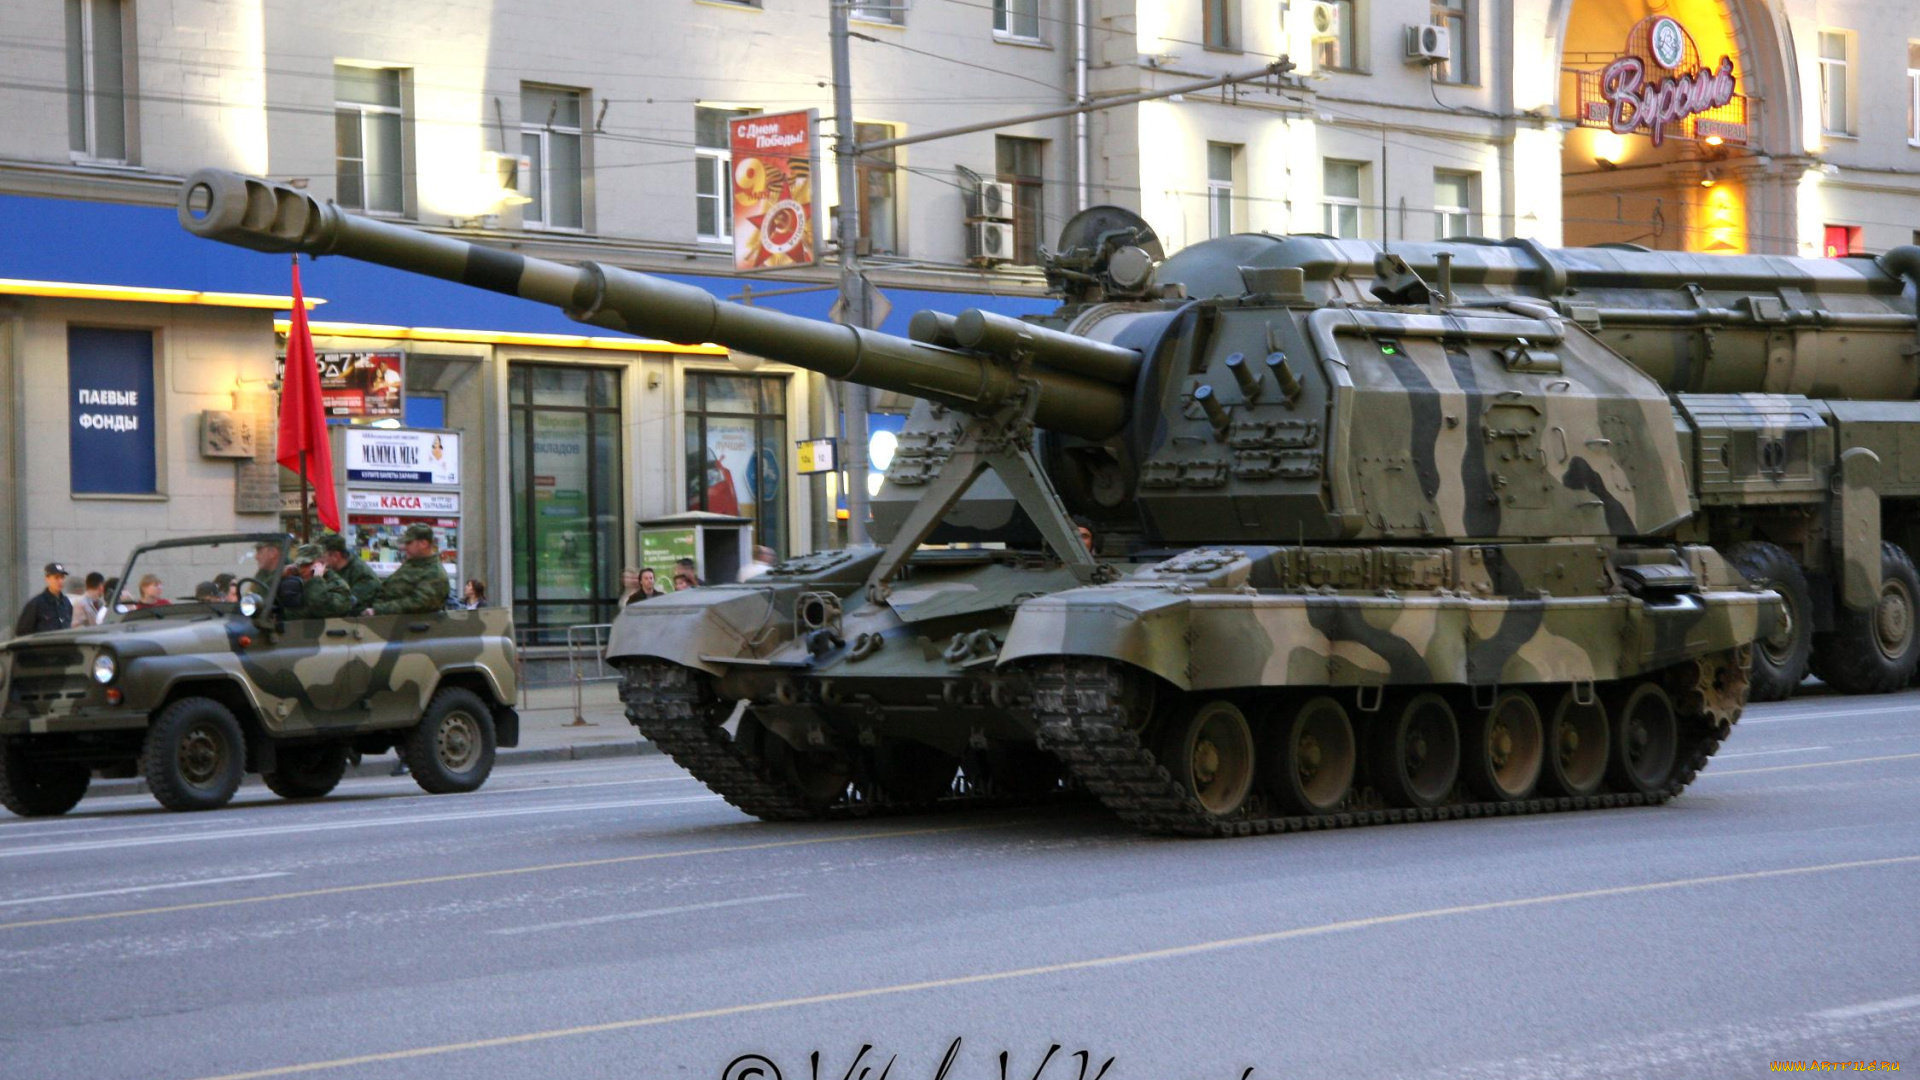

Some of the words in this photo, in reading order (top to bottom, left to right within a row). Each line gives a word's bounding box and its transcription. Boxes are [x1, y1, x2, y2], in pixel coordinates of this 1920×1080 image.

[1589, 104, 1609, 120] БАР
[747, 123, 779, 139] Днем
[1699, 121, 1747, 138] РЕСТОРАН
[756, 130, 804, 149] Победы!
[735, 157, 766, 206] 9
[79, 388, 138, 406] ПАЕВЫЕ
[79, 413, 138, 432] ФОНДЫ
[362, 444, 397, 463] MAMMA
[399, 446, 419, 465] MIA!
[380, 496, 421, 509] КАССА
